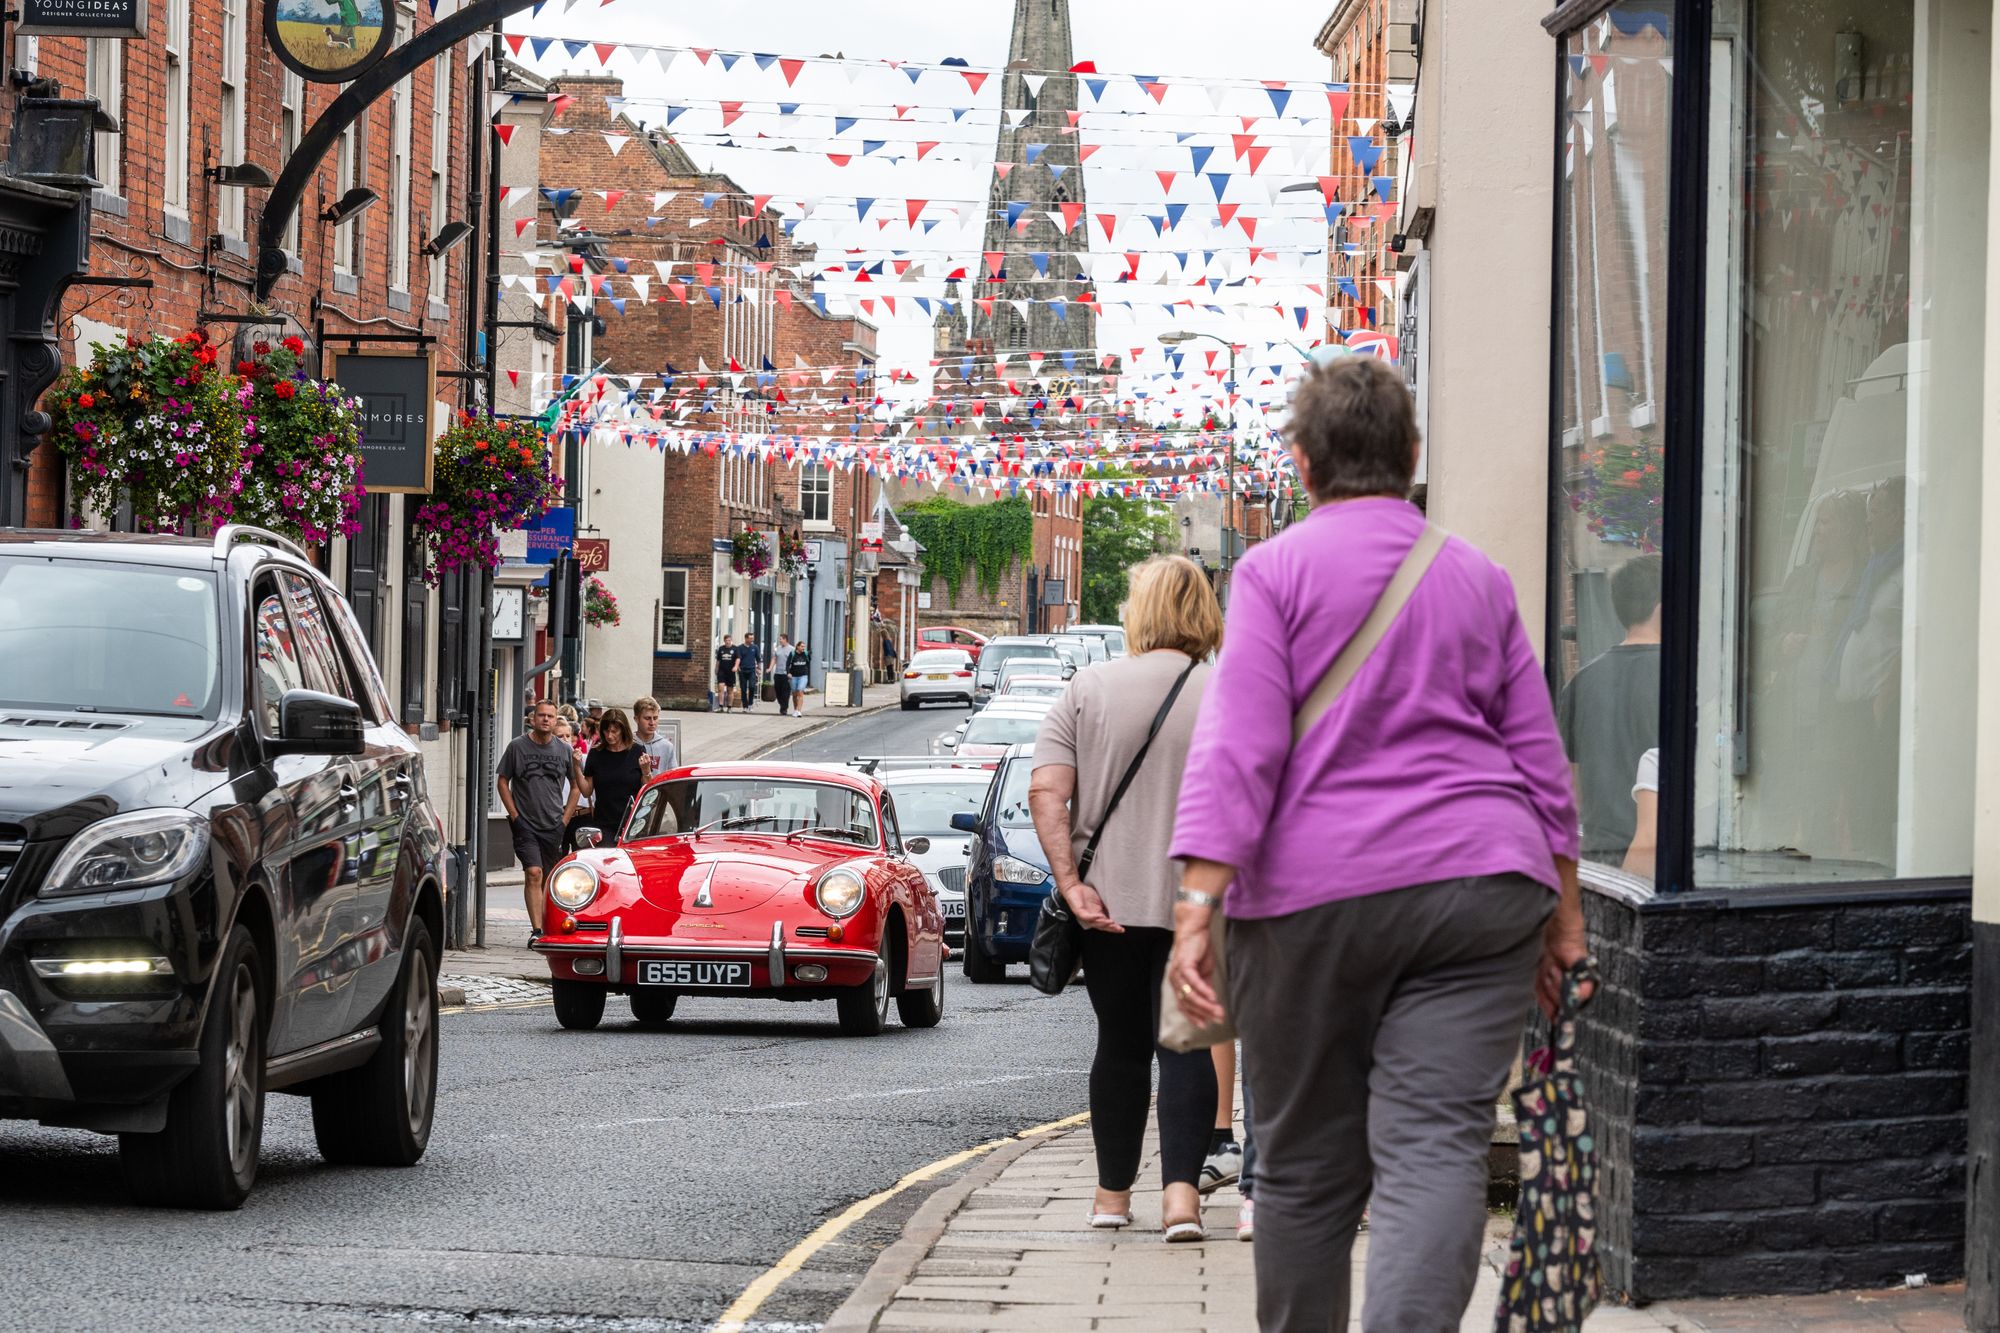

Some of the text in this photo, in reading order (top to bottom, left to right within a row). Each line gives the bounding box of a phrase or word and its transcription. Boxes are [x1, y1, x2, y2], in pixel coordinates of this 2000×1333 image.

[360, 413, 424, 423] NMORES
[528, 534, 570, 543] SSURANCE
[527, 541, 560, 550] ERVICES
[578, 546, 603, 569] afé
[647, 963, 742, 984] 655 UYP
